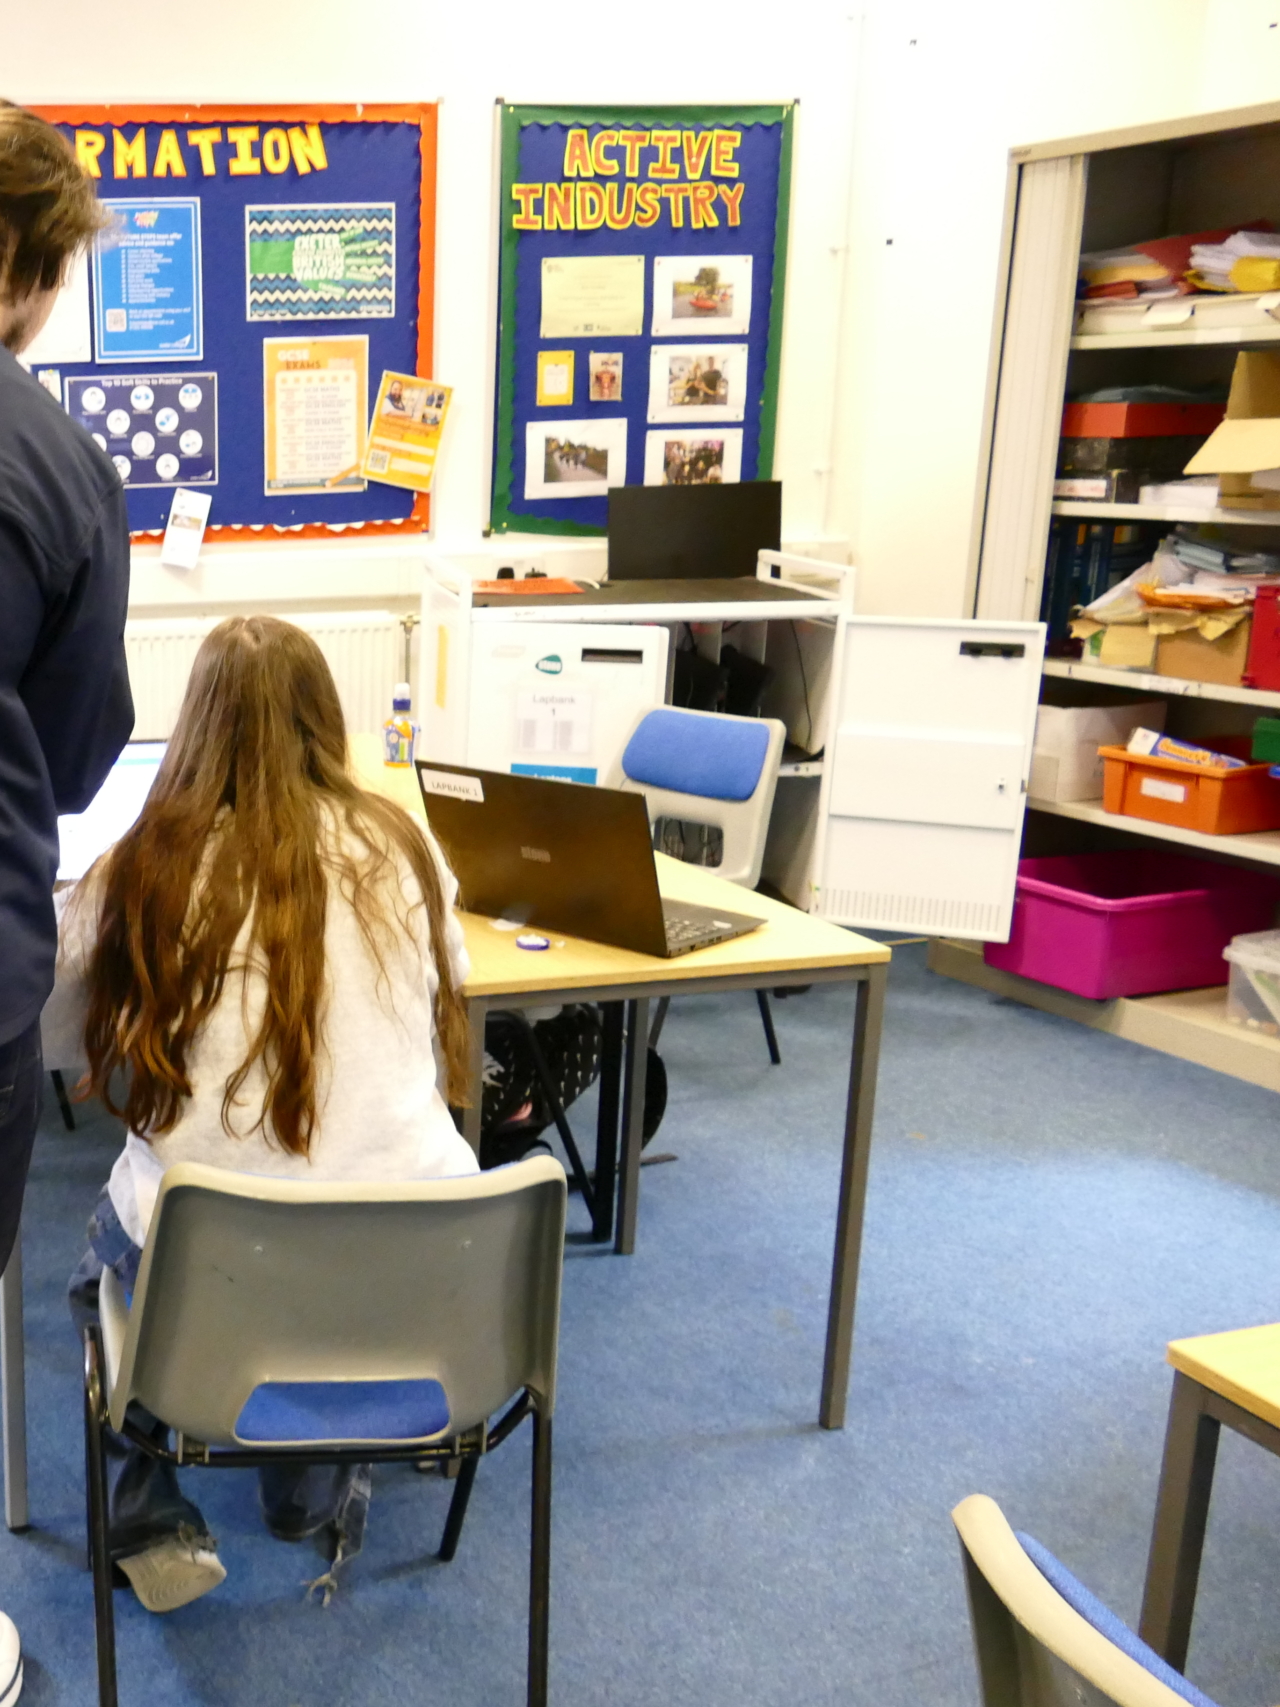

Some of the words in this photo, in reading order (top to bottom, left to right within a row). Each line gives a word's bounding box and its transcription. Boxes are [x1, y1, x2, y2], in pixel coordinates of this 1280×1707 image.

[75, 124, 328, 179] RMATION
[564, 129, 741, 179] ACTIVE
[512, 182, 745, 230] INDUSTRY
[277, 349, 310, 361] GCSE
[285, 360, 321, 370] EXAMS
[532, 694, 576, 705] Lapbank
[431, 781, 471, 796] LAPBANK
